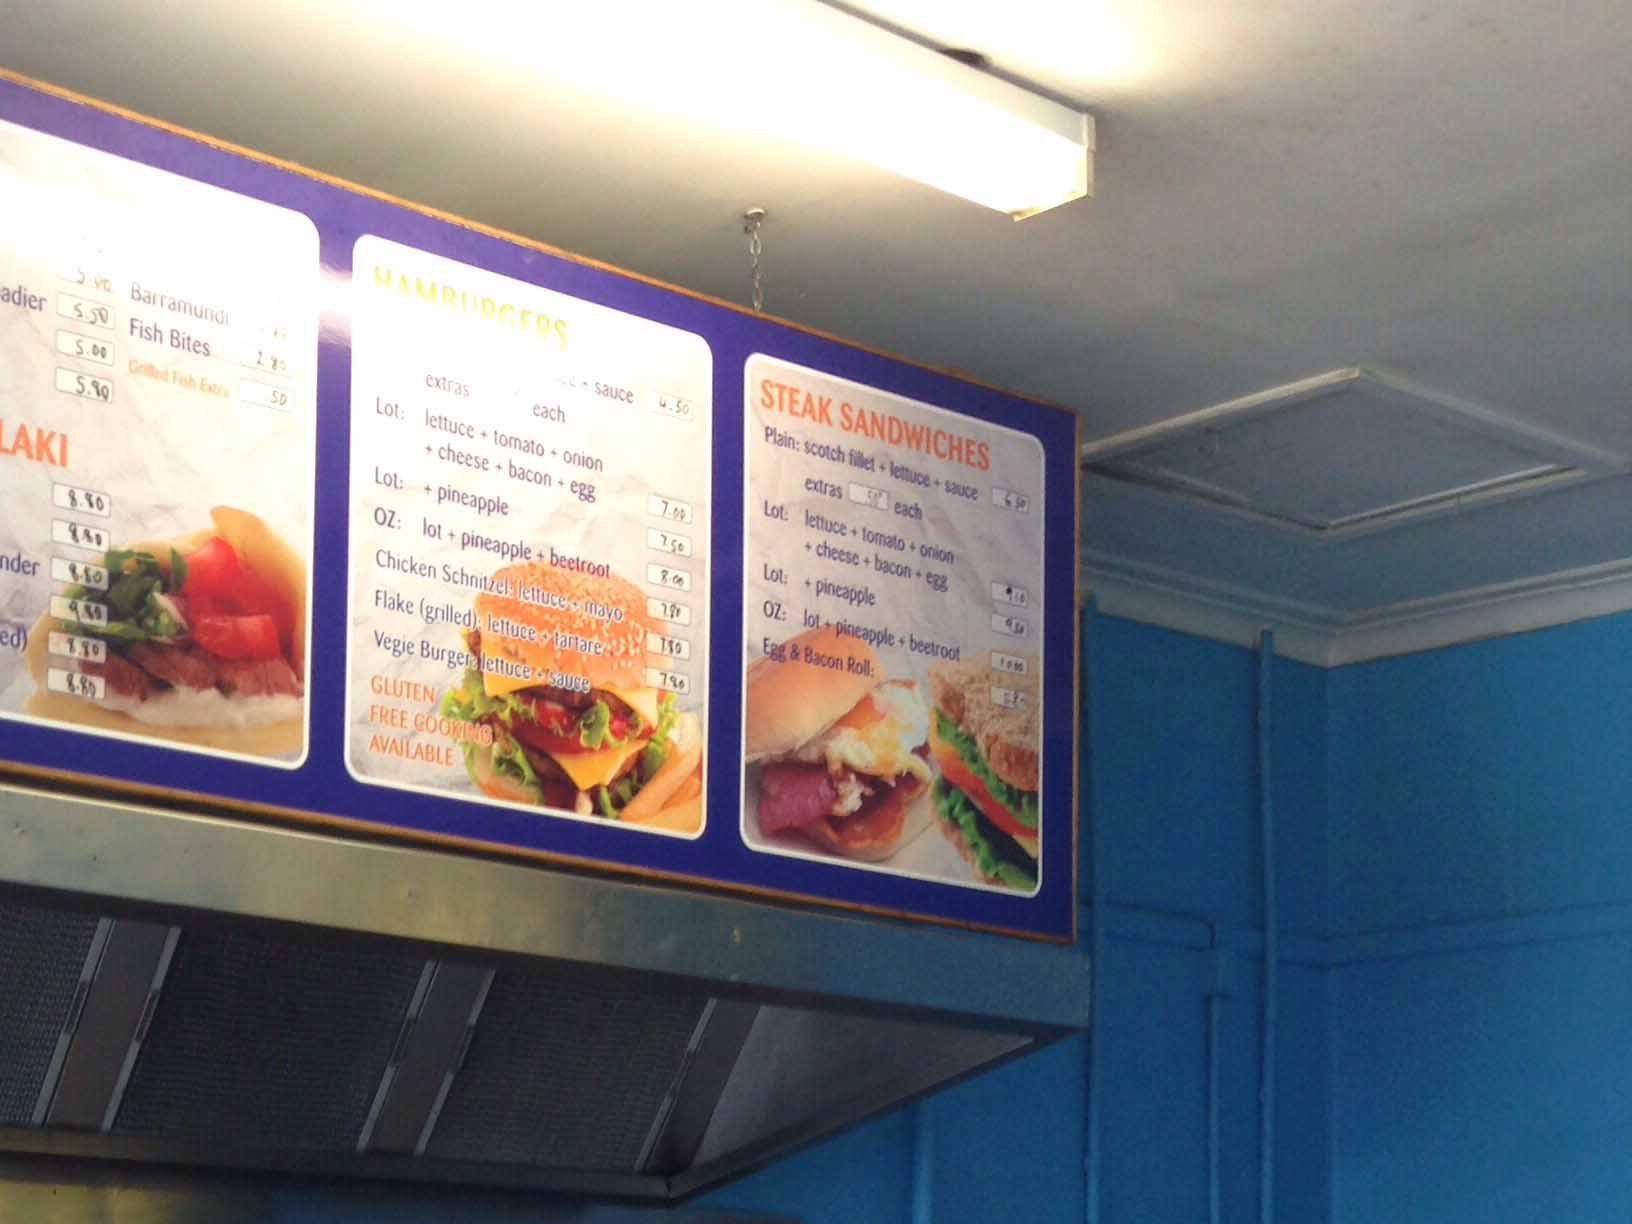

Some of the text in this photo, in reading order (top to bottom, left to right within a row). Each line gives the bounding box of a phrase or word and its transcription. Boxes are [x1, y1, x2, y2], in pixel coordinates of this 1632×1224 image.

[130, 281, 231, 326] Barramundi
[130, 317, 211, 357] Fish Bites
[425, 374, 566, 423] extras each
[594, 382, 634, 403] sauce
[376, 396, 603, 472] Lot: lettuce tomato onion
[761, 379, 991, 471] STEAK SANDWICHES
[438, 443, 596, 503] cheese bacon egg
[764, 426, 978, 500] Plain: scotch fillet lettuce sauce
[375, 466, 509, 517] Lot: pineapple
[805, 478, 922, 520] extras each
[374, 506, 611, 579] OZ: lot pineapple beetroot
[764, 500, 955, 565] Lot: lettuce tomato onion
[376, 549, 623, 622] Chicken Schnitzel: lettuce mayo
[764, 563, 876, 607] Lot: pineapple
[816, 540, 948, 592] cheese bacon egg
[375, 590, 414, 615] Flake
[488, 613, 536, 641] lettuce
[555, 632, 602, 655] tartare
[763, 600, 960, 662] OZ: lot pineapple beetroot
[374, 629, 590, 692] Vegie lettuce sauce
[763, 637, 874, 678] Egg Bacon Roll:
[371, 675, 437, 703] GLUTEN
[370, 704, 493, 744] FREE COOKING
[370, 735, 455, 766] AVAILABLE
